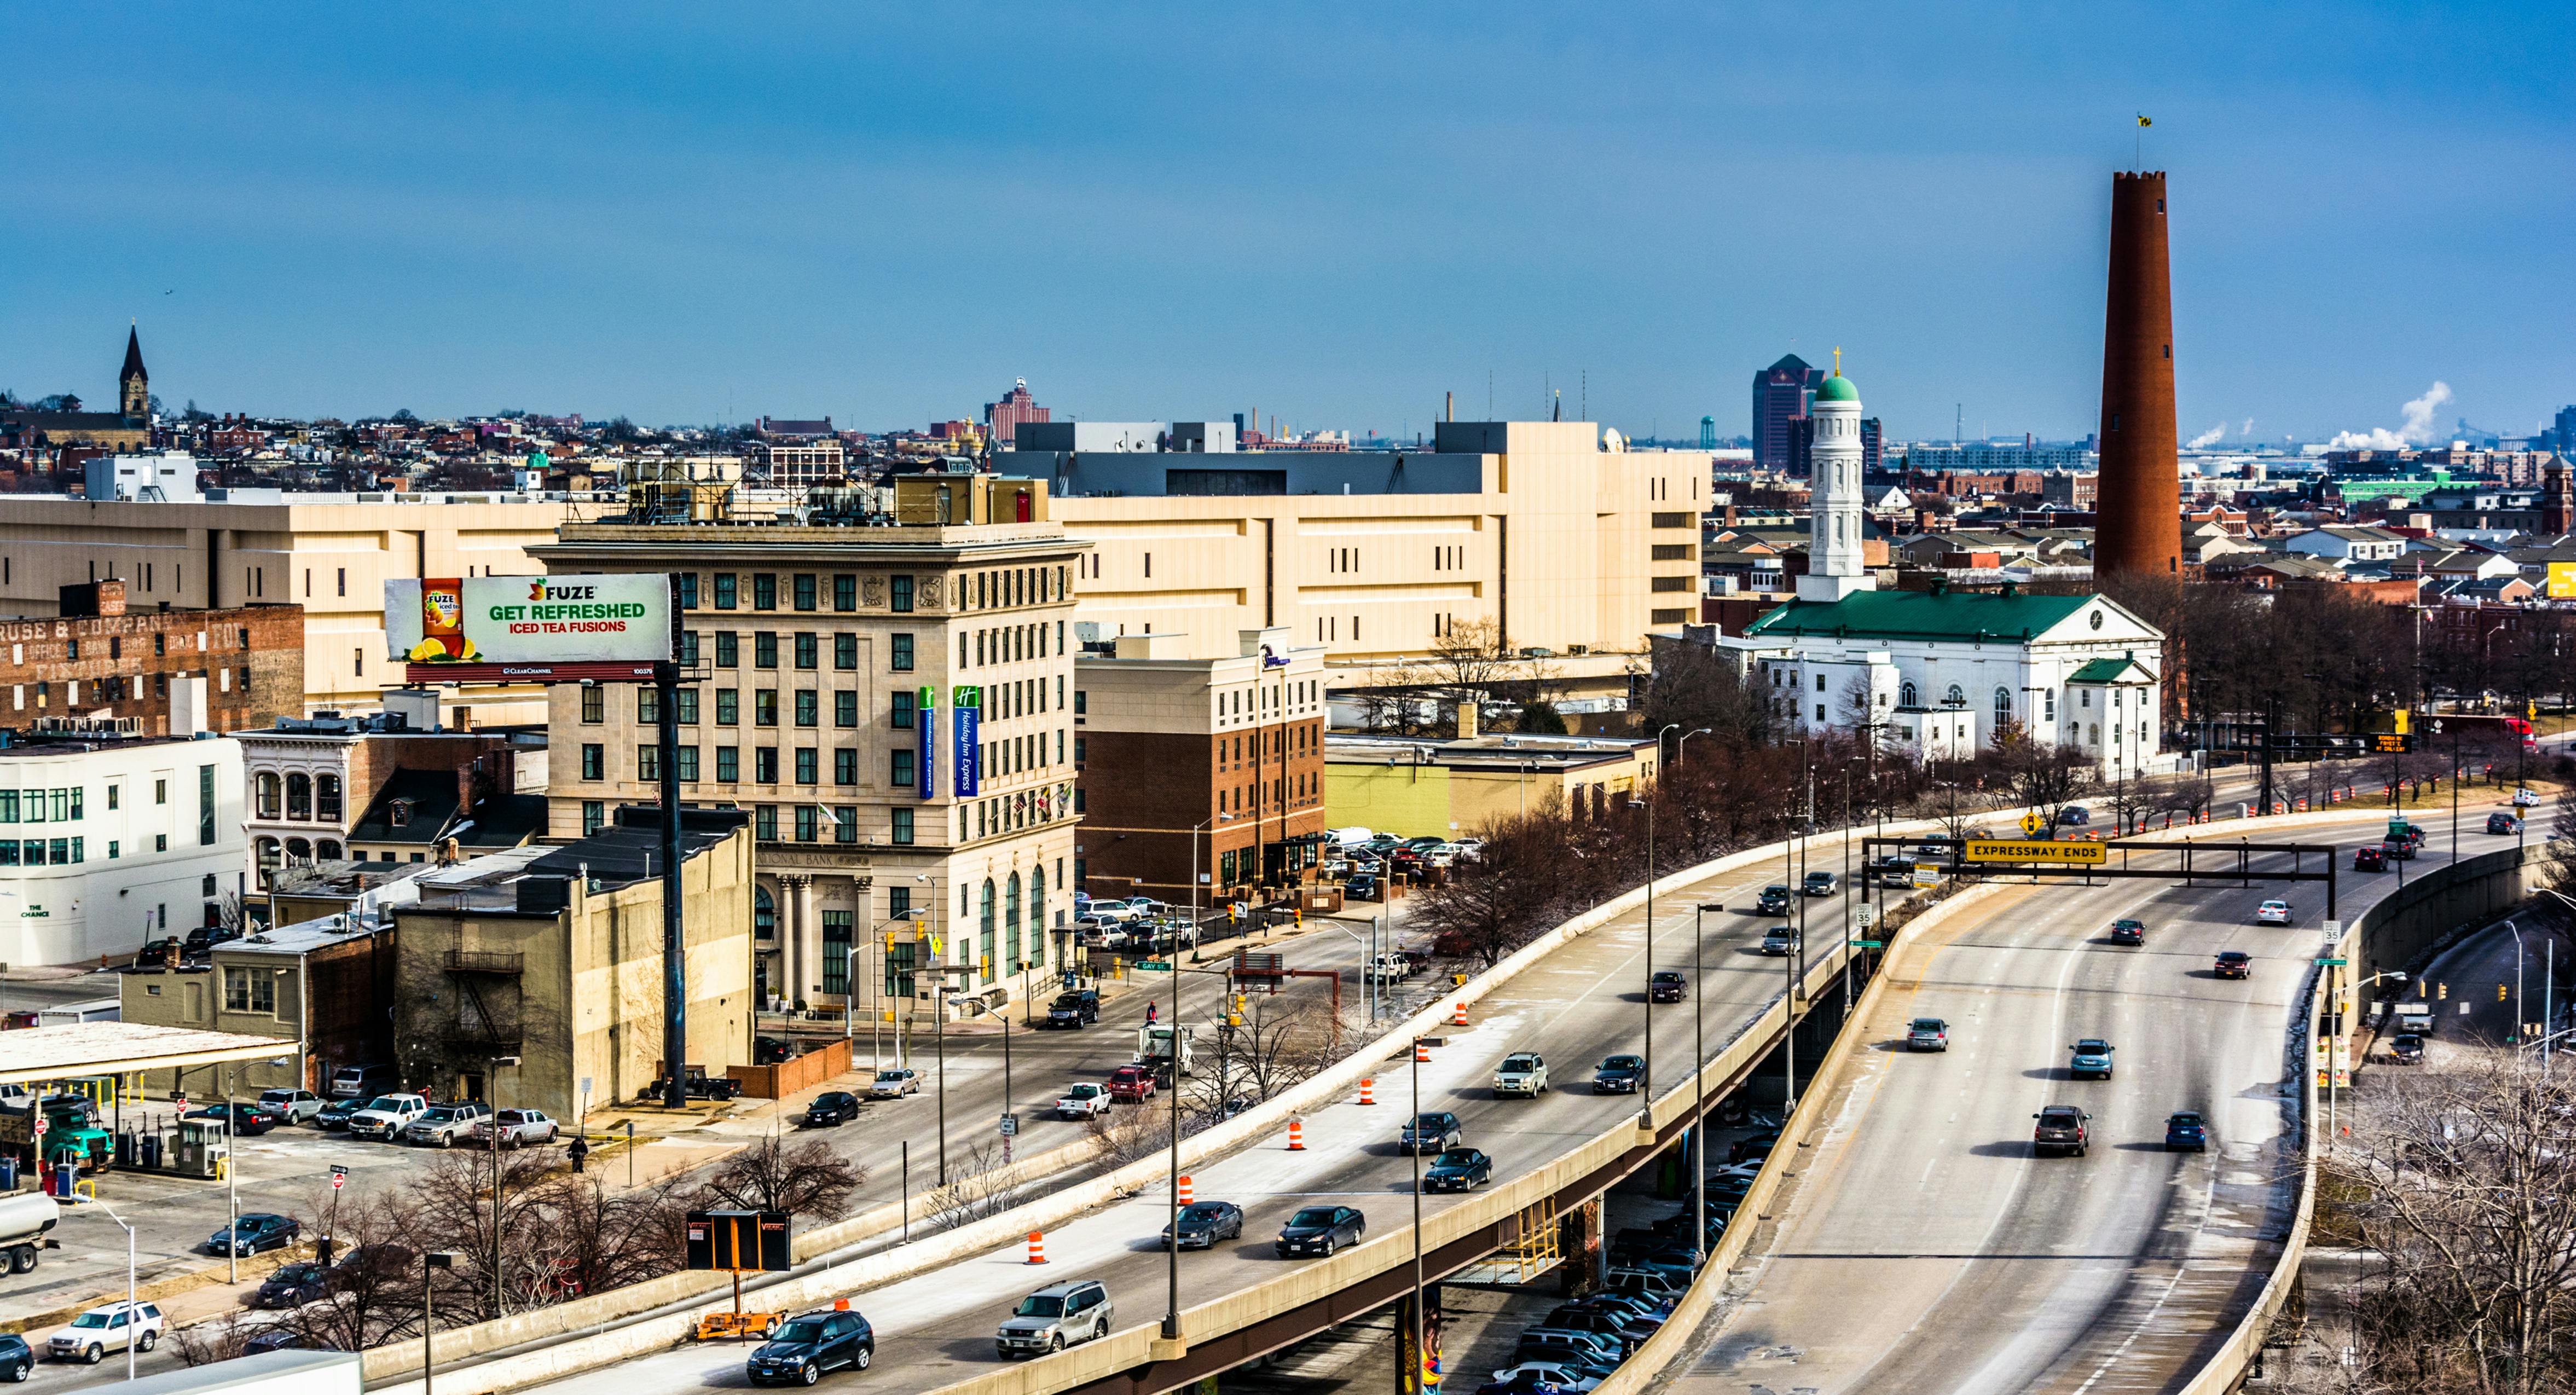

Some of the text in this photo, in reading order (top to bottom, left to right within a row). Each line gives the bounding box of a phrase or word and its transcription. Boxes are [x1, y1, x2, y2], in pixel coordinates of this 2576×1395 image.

[546, 586, 594, 600] FUZE
[489, 603, 645, 621] GET REFRESHED
[56, 621, 68, 638] &
[510, 621, 626, 634] ICED TEA FUSIONS
[170, 634, 193, 650] DRG
[36, 658, 143, 680] FIXTURES
[961, 711, 971, 791] Holiday Inn Express
[756, 853, 832, 865] ATIONAL BANK
[1975, 846, 2097, 857] EXPRESSWAY ENDS
